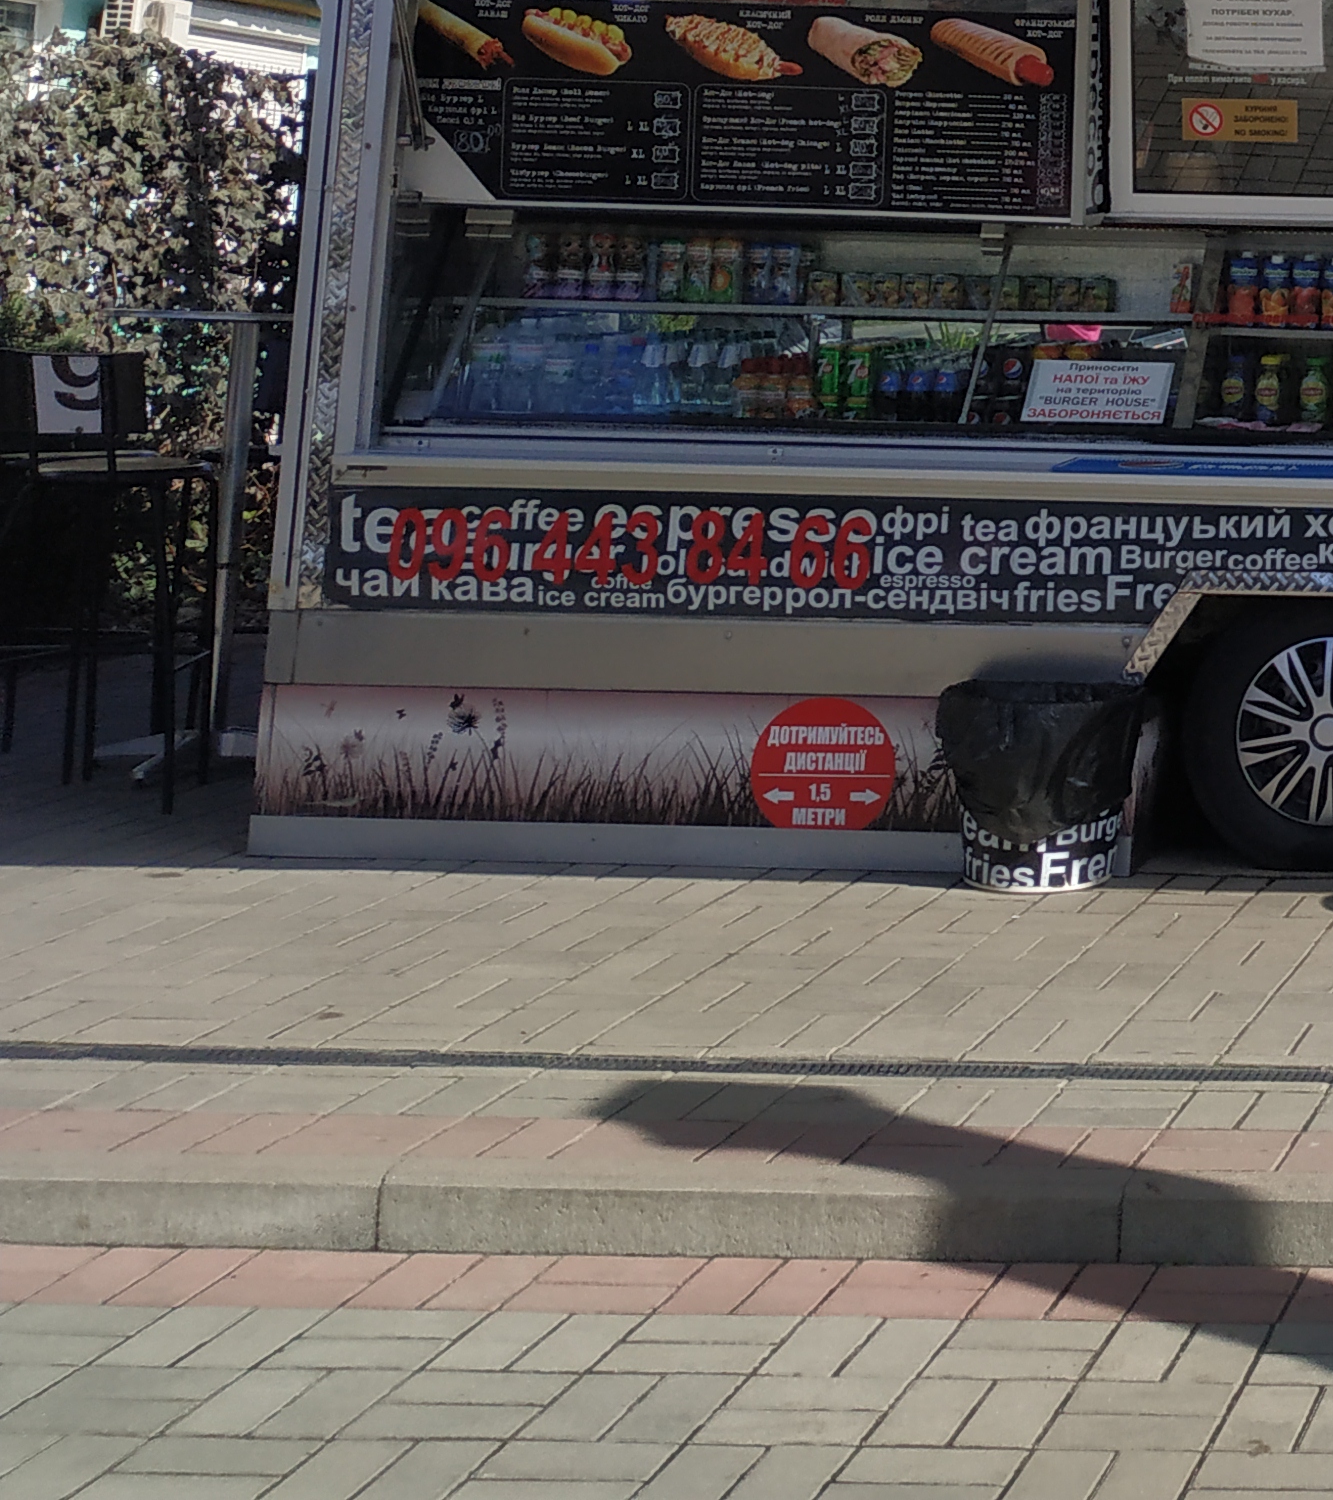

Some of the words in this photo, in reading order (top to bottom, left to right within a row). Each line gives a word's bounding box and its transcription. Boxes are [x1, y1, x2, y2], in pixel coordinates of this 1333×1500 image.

[1069, 361, 1140, 373] Приносити
[1053, 373, 1099, 385] НАПОЇ
[1103, 376, 1119, 385] та
[1122, 373, 1151, 387] ЇЖУ
[1056, 385, 1073, 395] на
[1076, 385, 1142, 397] територію
[1027, 408, 1161, 422] ЗАБОРОНЯЄТЬСЯ
[881, 506, 950, 541] фрі
[961, 512, 1019, 542] tea
[387, 506, 513, 584] 096
[532, 511, 659, 587] 443
[686, 510, 768, 587] 84
[790, 514, 871, 591] 66
[961, 543, 1112, 576] cream
[1227, 551, 1319, 572] coffee
[879, 574, 976, 590] espresso
[584, 589, 665, 609] cream
[1015, 584, 1101, 614] fries
[767, 724, 885, 747] ДОТРИМУЙТЕСЬ
[784, 749, 867, 773] ДИСТАНЦІЇ
[808, 783, 832, 803] 1,5
[792, 807, 846, 827] МЕТРИ
[965, 846, 1035, 888] fries
